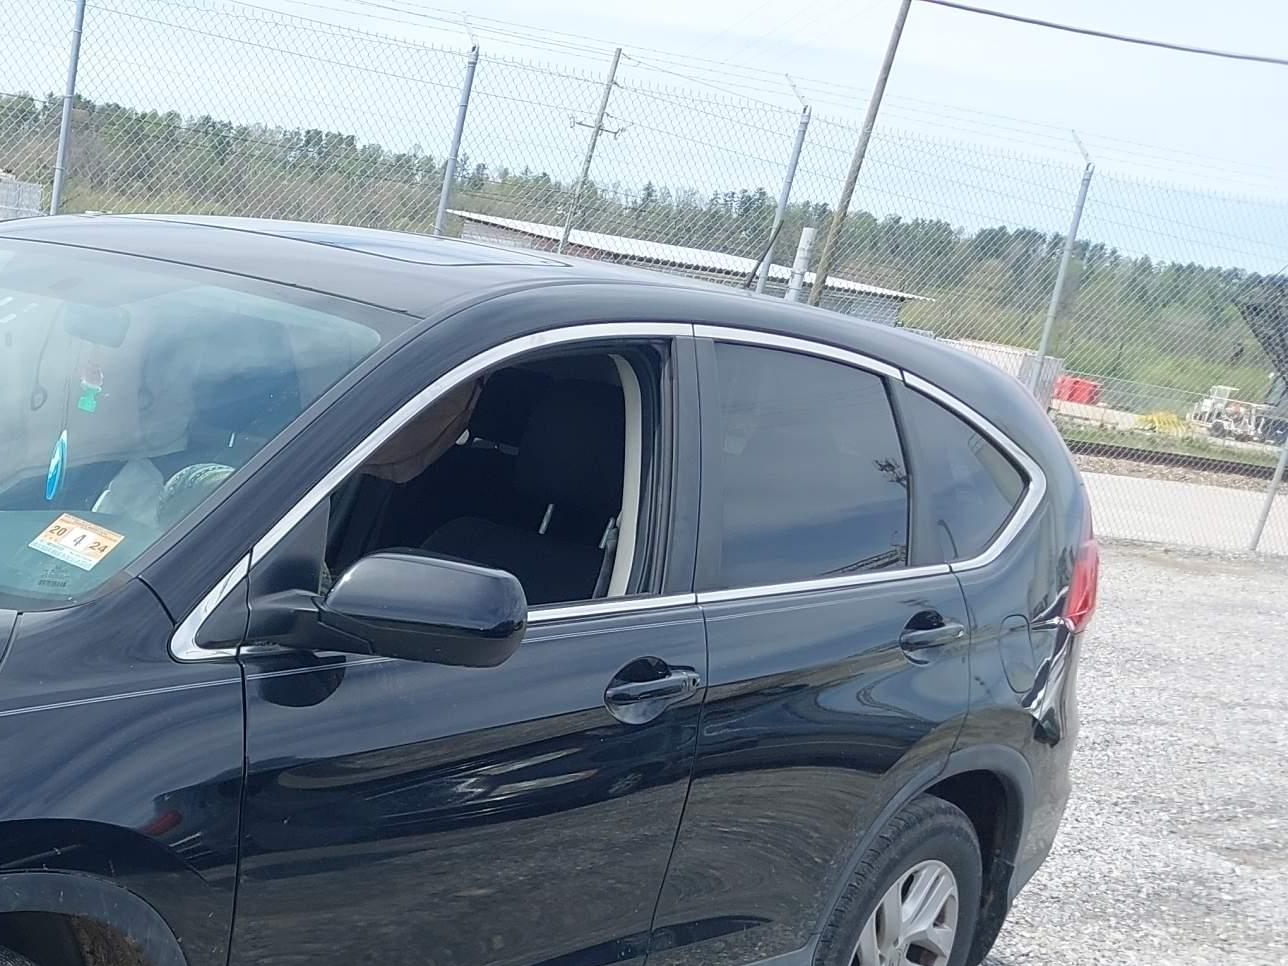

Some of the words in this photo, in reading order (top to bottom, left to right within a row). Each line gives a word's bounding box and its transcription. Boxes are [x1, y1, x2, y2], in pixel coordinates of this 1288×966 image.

[49, 525, 68, 537] 20
[72, 534, 87, 547] 4
[88, 541, 108, 553] 24
